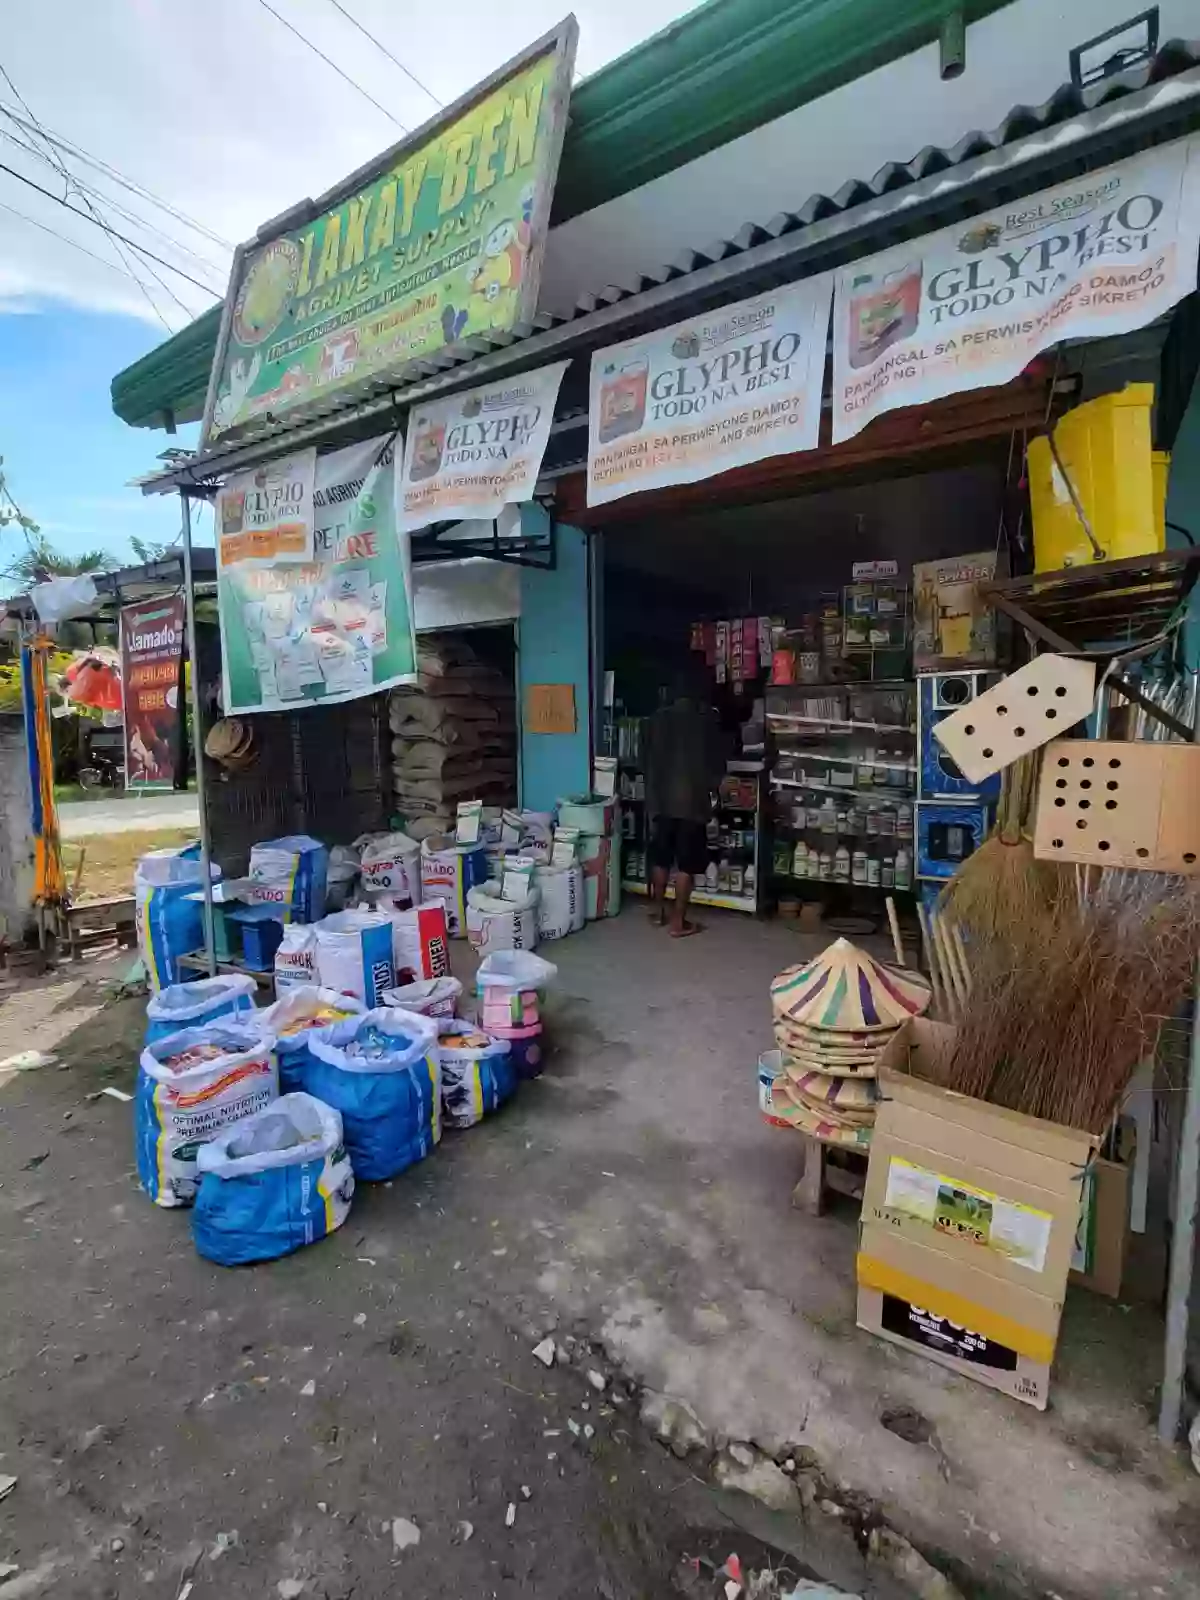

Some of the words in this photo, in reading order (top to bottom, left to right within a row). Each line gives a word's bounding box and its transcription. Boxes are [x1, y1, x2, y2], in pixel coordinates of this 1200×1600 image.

[296, 158, 429, 298] LAKAY
[438, 80, 545, 215] BEN
[1005, 206, 1043, 231] Best
[1051, 176, 1121, 216] Season
[294, 262, 381, 325] AGRIVET
[392, 200, 496, 271] SUPPLY
[926, 194, 1163, 302] GLYPHO
[929, 287, 1016, 325] TODO
[1077, 231, 1152, 269] BEST
[934, 340, 957, 356] SA
[1089, 256, 1165, 291] DAMO?
[650, 332, 801, 401] GLYPHO
[651, 396, 706, 421] TODO
[711, 387, 740, 405] NA
[745, 362, 797, 393] BEST
[893, 366, 917, 382] NG
[653, 437, 669, 450] SA
[752, 396, 801, 420] DAMO?
[719, 425, 743, 445] ANG
[127, 623, 175, 652] Llamado
[172, 1111, 217, 1126] OPTIMAL
[220, 1088, 271, 1115] NUTRITION
[227, 1101, 269, 1124] QUALITY
